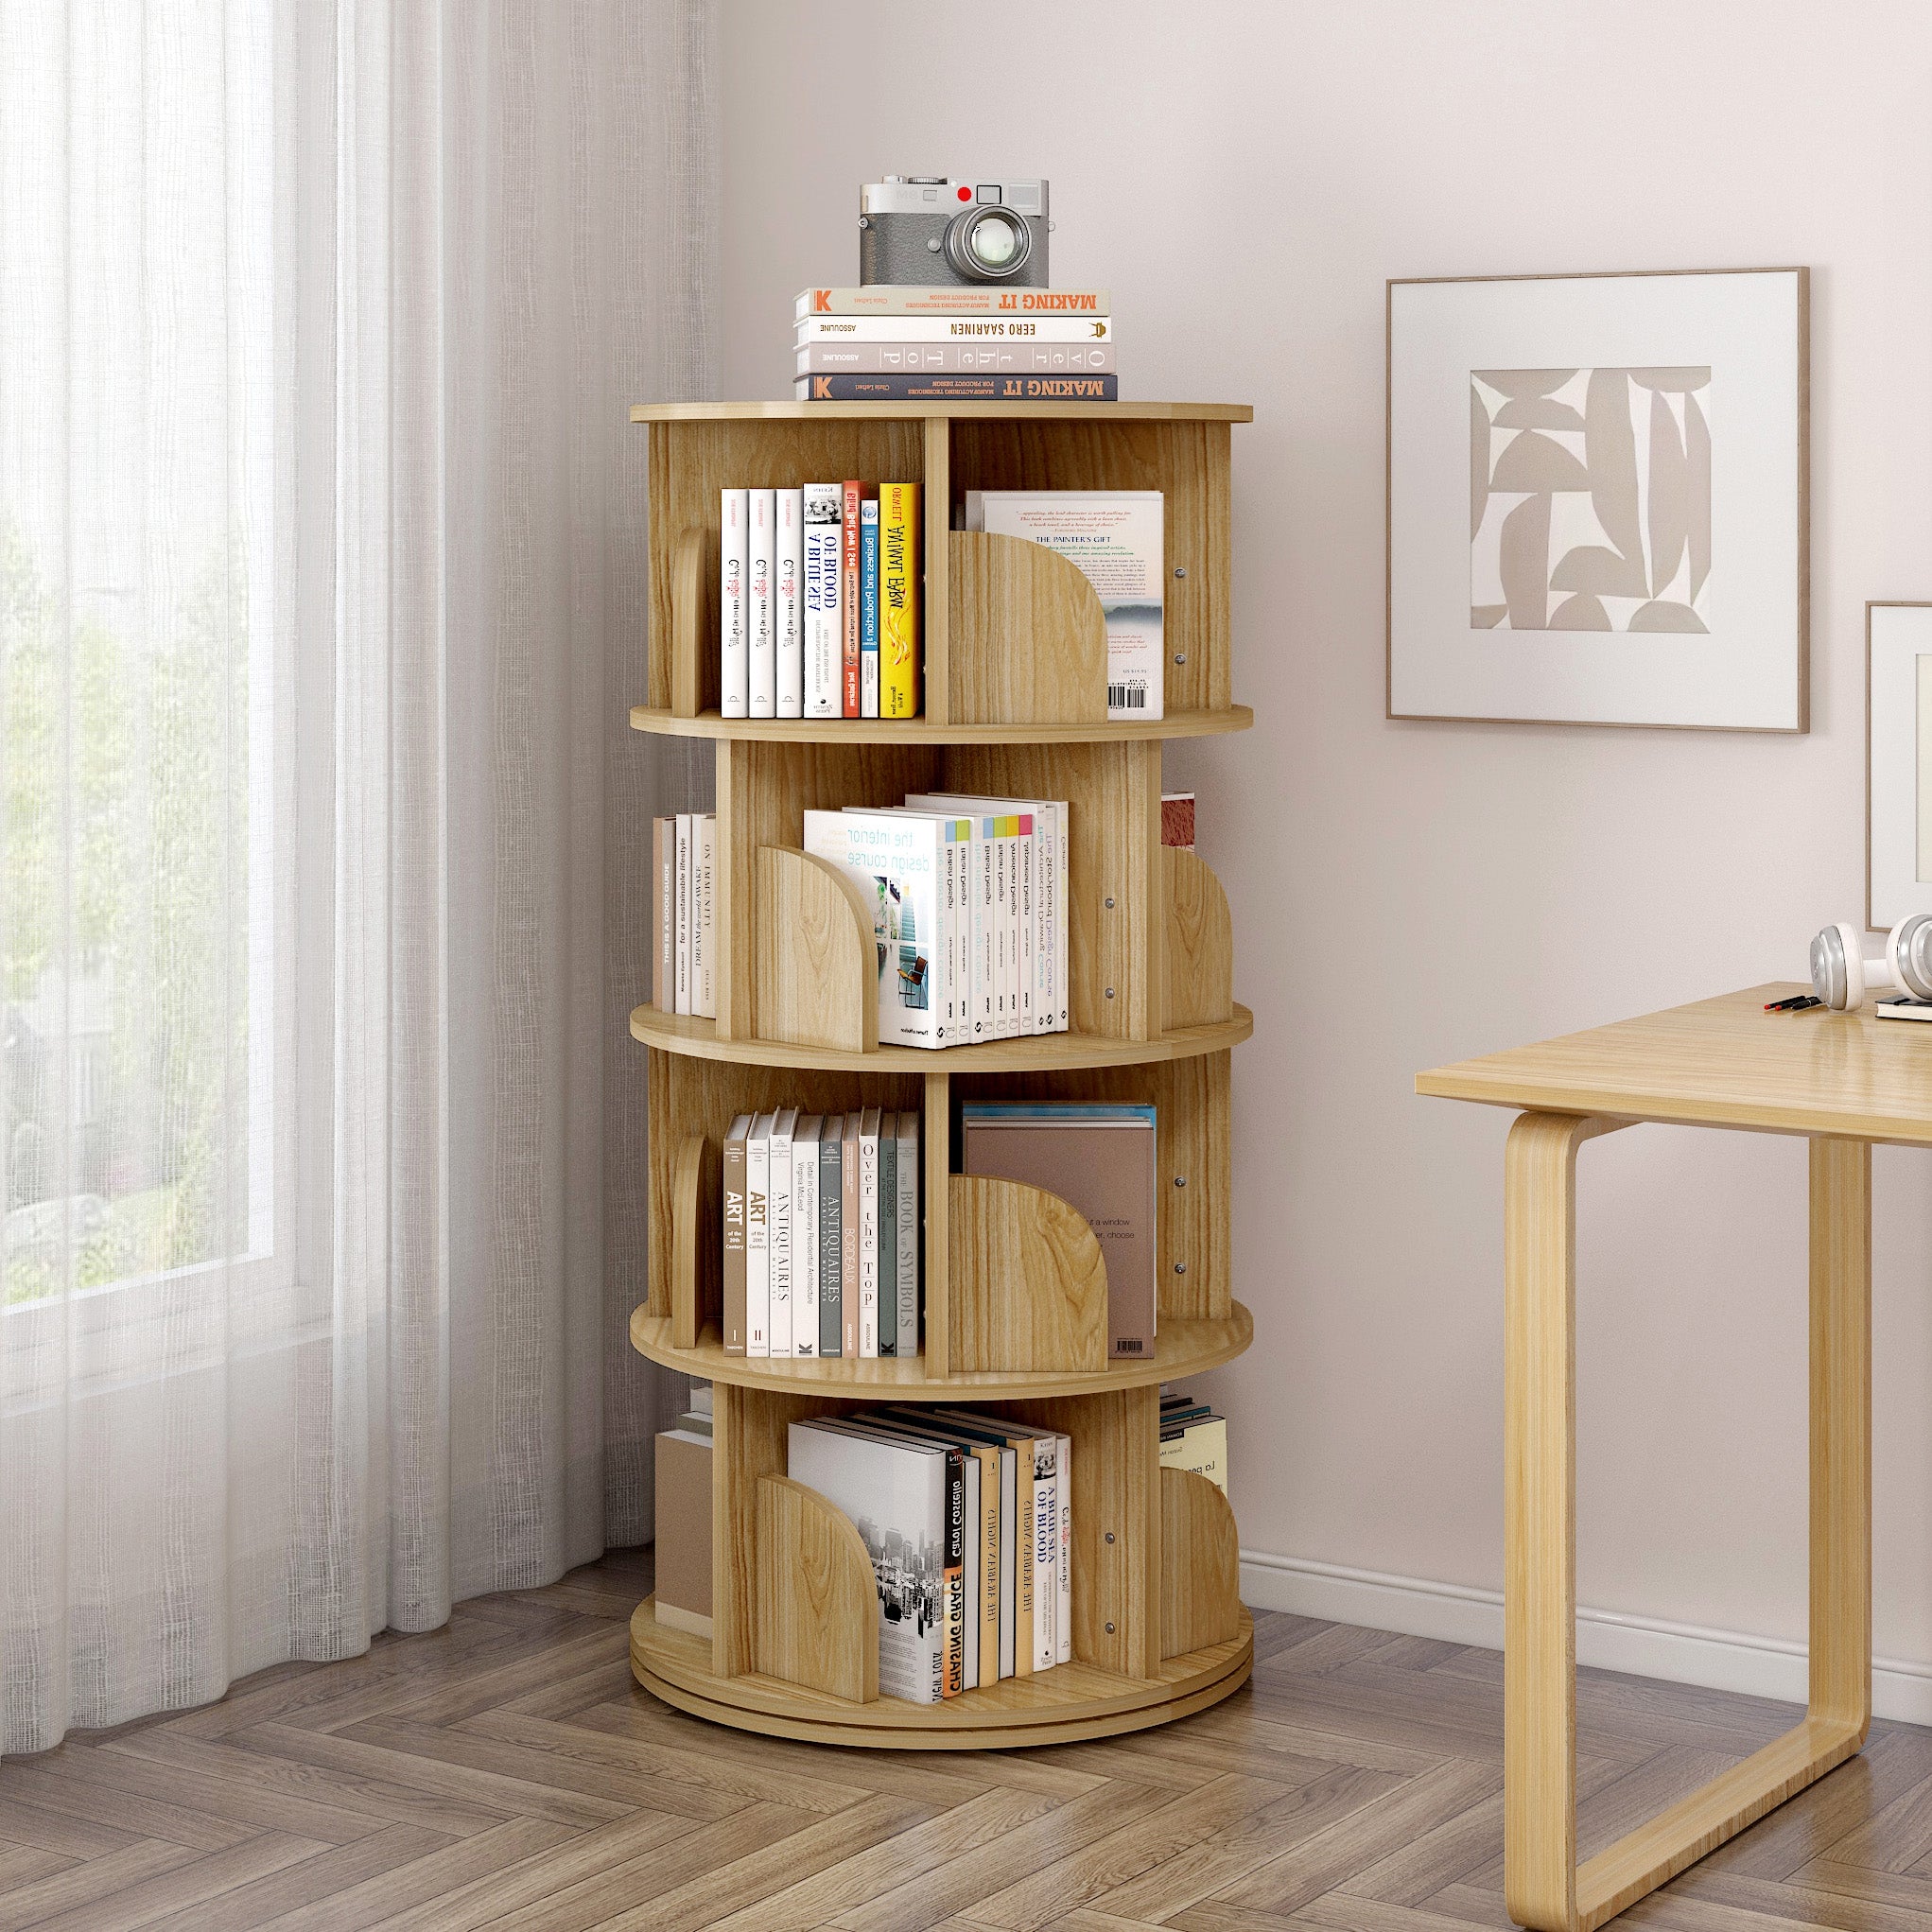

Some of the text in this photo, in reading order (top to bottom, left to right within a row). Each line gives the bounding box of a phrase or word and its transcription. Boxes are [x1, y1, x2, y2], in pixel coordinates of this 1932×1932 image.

[816, 290, 832, 312] K
[999, 295, 1096, 309] MAKING IT
[951, 324, 1036, 335] EERO SAARINEN
[884, 350, 1105, 366] Over the Top
[816, 377, 833, 398] K
[1003, 380, 1104, 396] MAKING IT
[704, 844, 710, 859] ON
[664, 933, 670, 941] IS
[863, 1144, 873, 1194] Over
[727, 1191, 743, 1225] ART
[751, 1191, 765, 1225] ART
[806, 1188, 814, 1231] Contemporary
[900, 1191, 913, 1233] BOOK
[776, 1192, 789, 1301] ANTIQUAIRES
[827, 1197, 839, 1302] ANTIQUAIRES
[844, 1228, 855, 1284] BORDEAUX
[863, 1262, 873, 1305] Top
[900, 1251, 914, 1327] SYMBOLS
[1037, 1491, 1047, 1563] OF BLOOD
